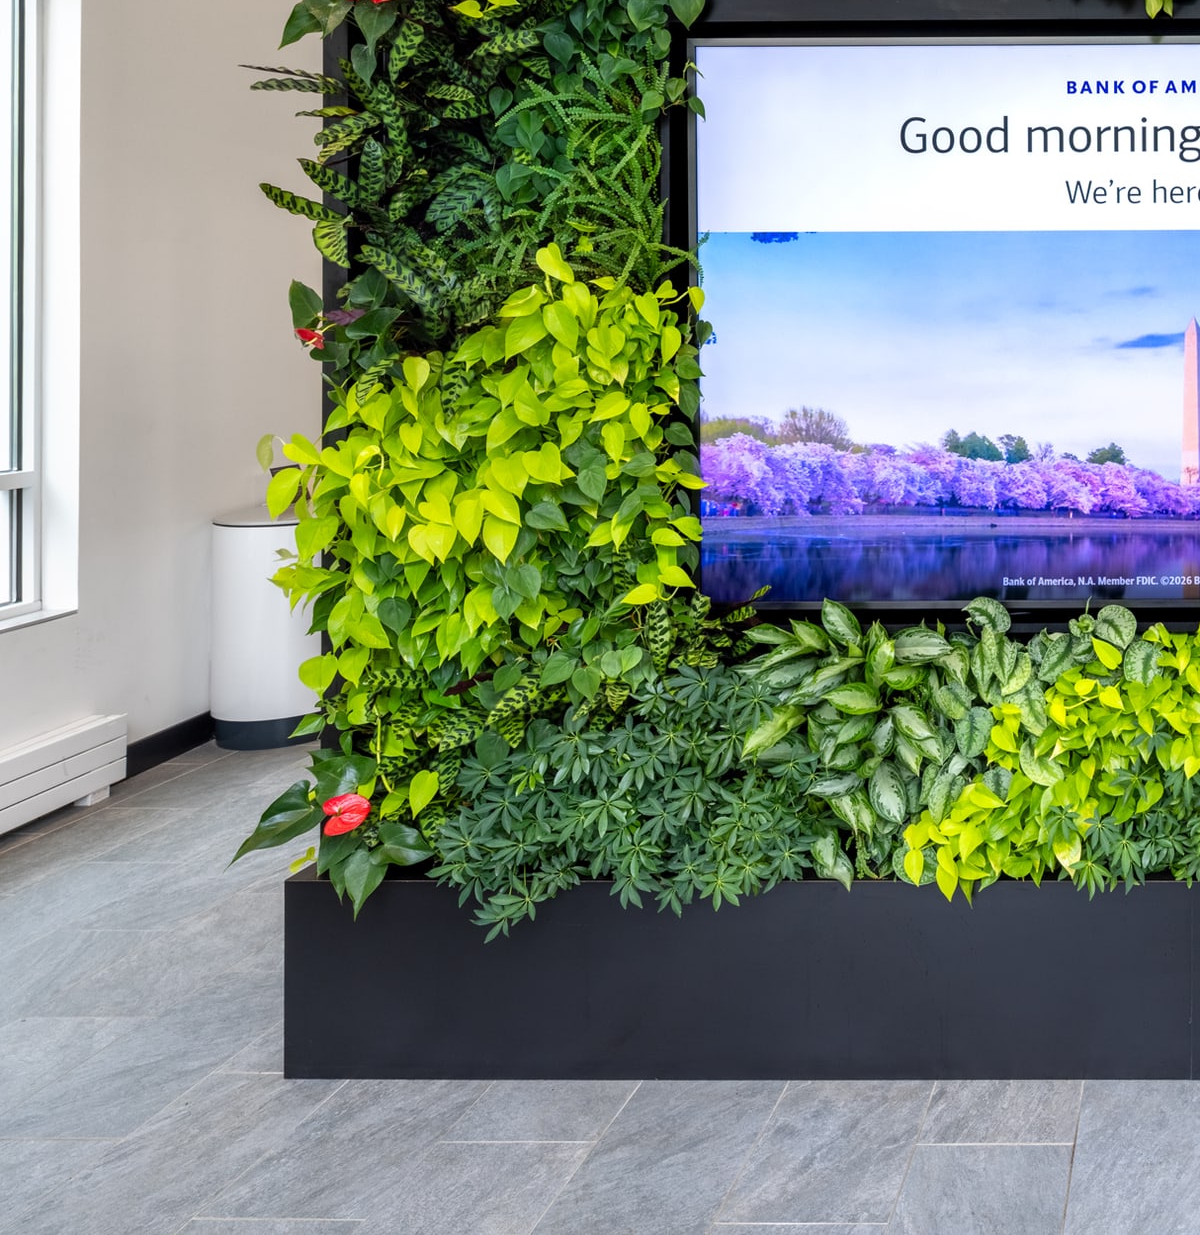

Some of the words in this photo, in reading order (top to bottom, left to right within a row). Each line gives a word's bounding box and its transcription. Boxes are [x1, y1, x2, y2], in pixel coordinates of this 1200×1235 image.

[1066, 80, 1125, 95] BANK
[1131, 80, 1159, 94] OF
[899, 115, 1009, 154] Good
[1002, 576, 1026, 587] Bank
[1026, 576, 1037, 587] of
[1038, 576, 1077, 588] America,
[1077, 575, 1096, 586] N.A.
[1097, 575, 1135, 586] Member
[1136, 575, 1159, 586] FDIC.
[1160, 575, 1193, 586] ©2026
